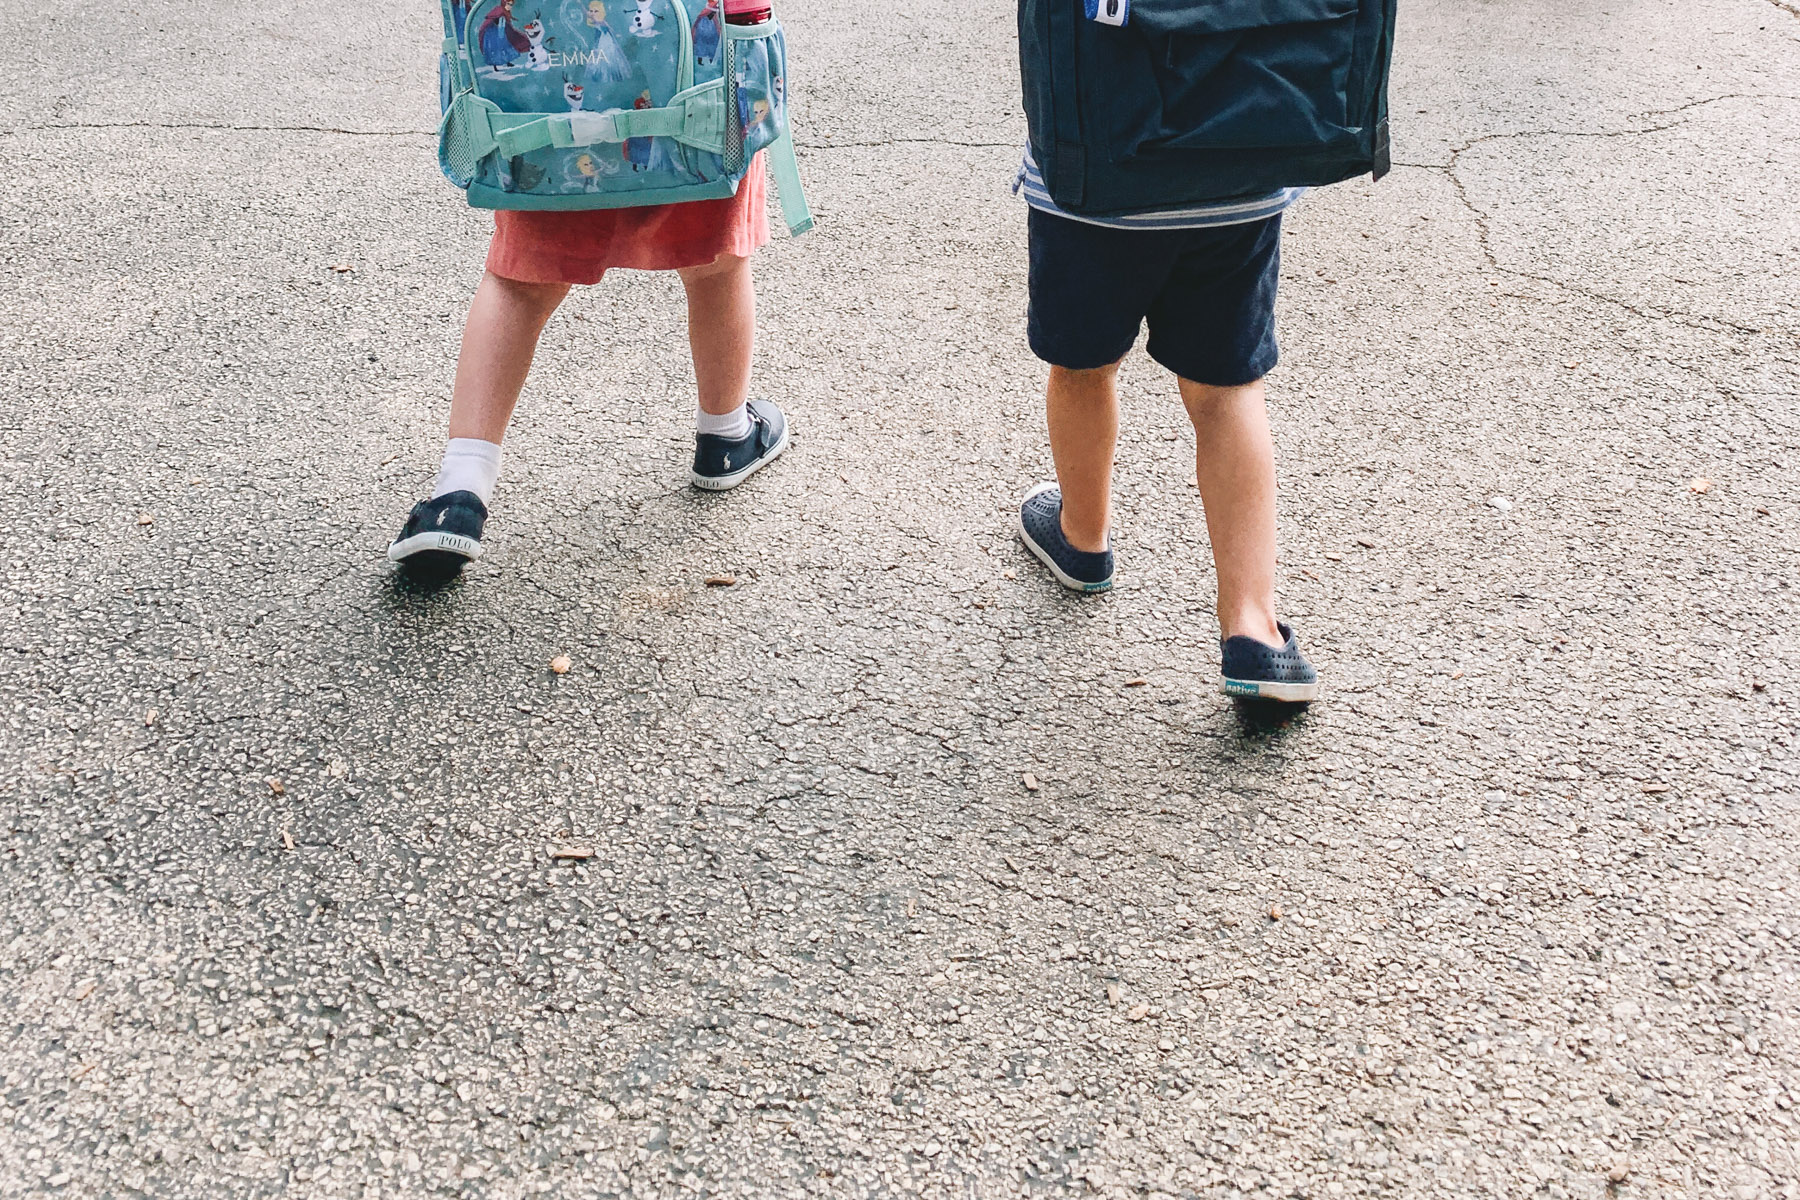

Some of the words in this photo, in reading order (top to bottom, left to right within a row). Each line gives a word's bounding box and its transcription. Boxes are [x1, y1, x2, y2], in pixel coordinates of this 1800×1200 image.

[547, 48, 610, 67] EMMA
[695, 476, 719, 488] POLO
[441, 535, 471, 550] POLO
[1227, 684, 1257, 695] native
